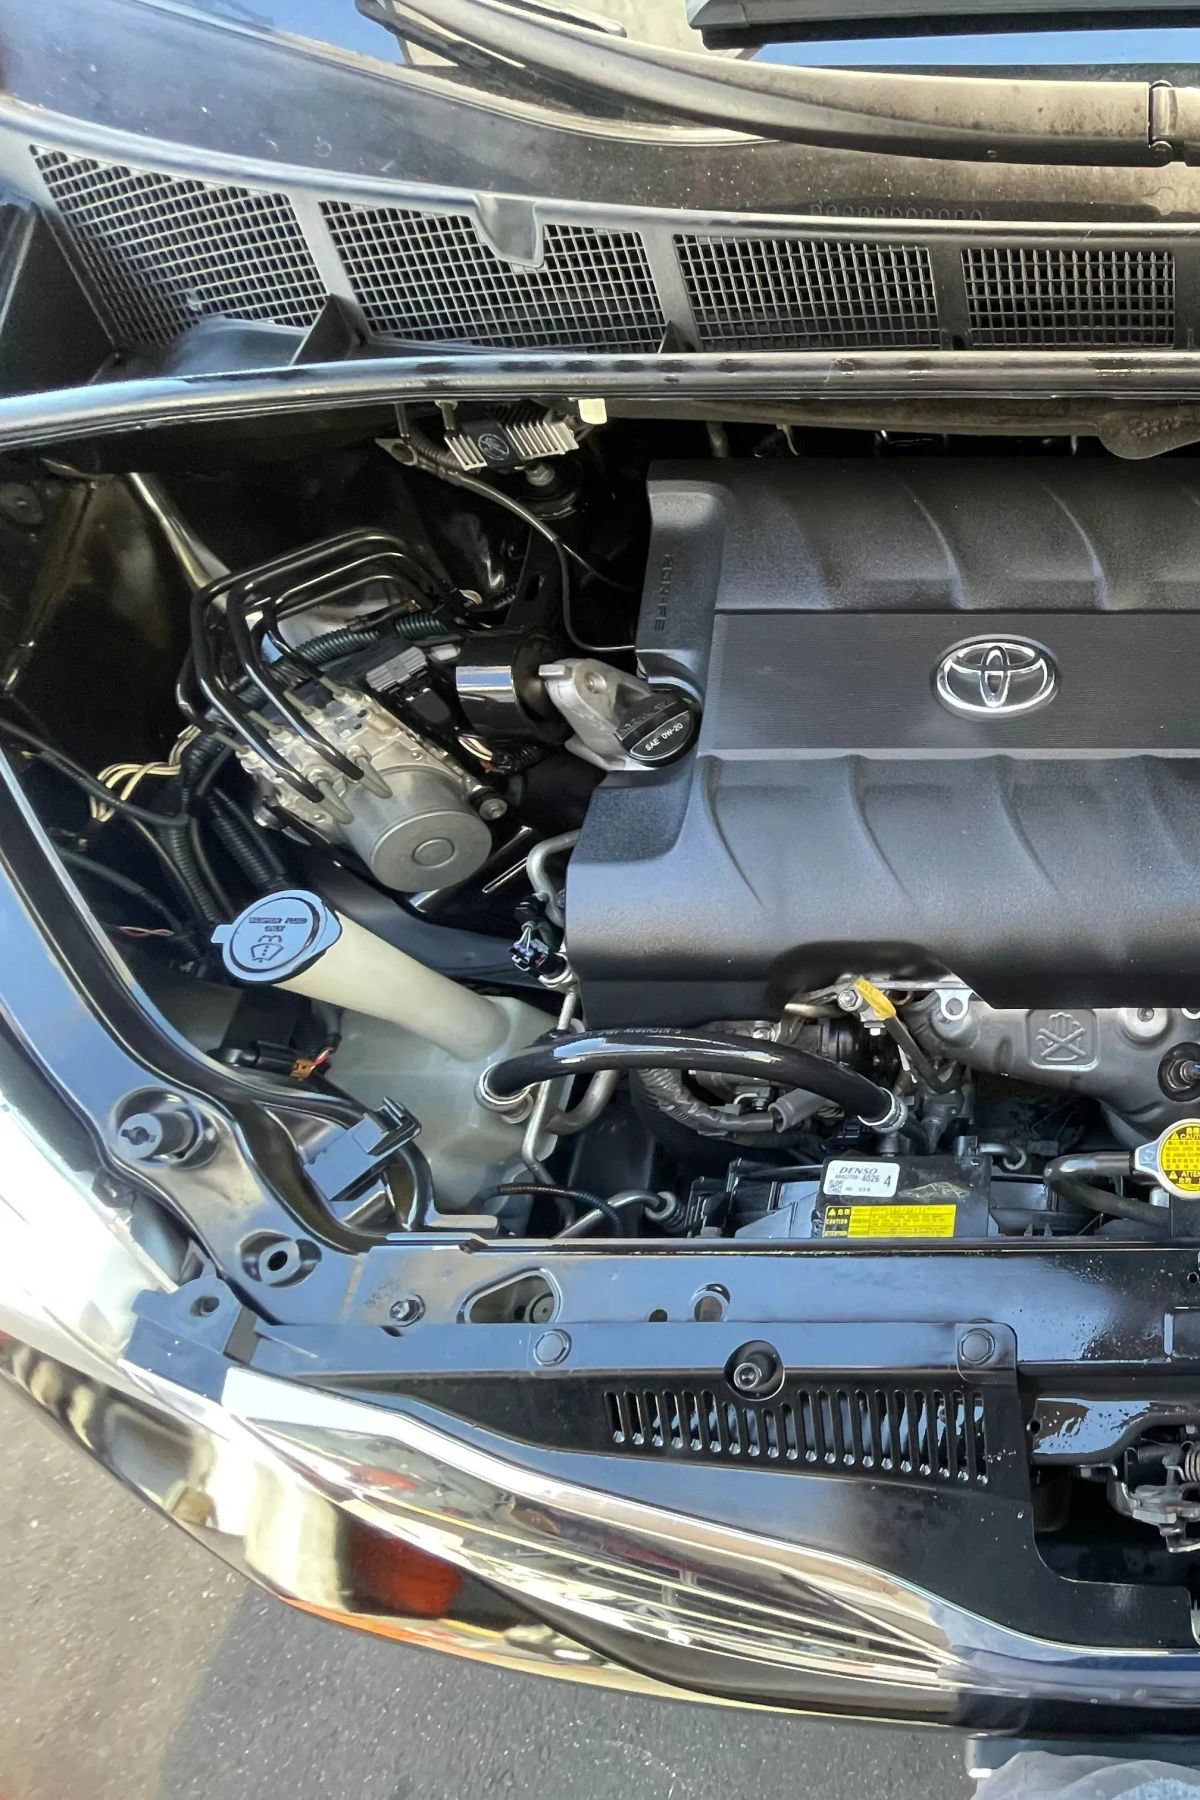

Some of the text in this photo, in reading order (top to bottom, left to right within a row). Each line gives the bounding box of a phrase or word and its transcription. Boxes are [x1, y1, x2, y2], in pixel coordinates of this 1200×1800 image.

[645, 722, 684, 751] SAE 0W-20
[840, 1166, 878, 1174] DENSO
[883, 1175, 892, 1187] 4
